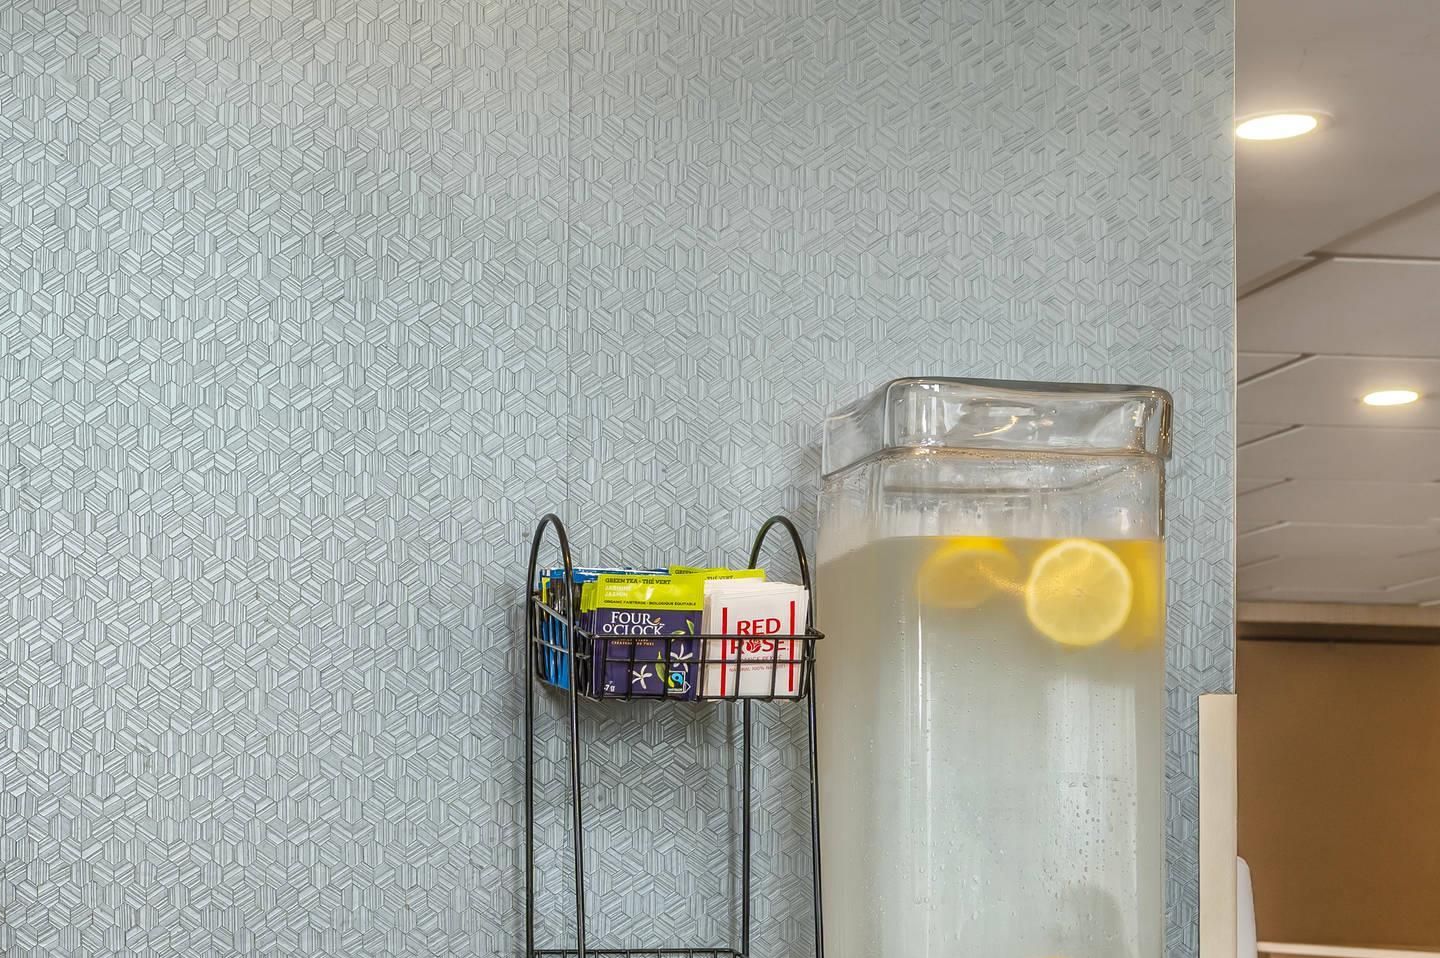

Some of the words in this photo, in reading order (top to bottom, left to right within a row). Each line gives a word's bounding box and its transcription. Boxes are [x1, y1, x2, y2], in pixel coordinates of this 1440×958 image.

[610, 612, 662, 626] FOUR
[602, 624, 663, 636] O'CLOCK
[736, 618, 782, 635] RED
